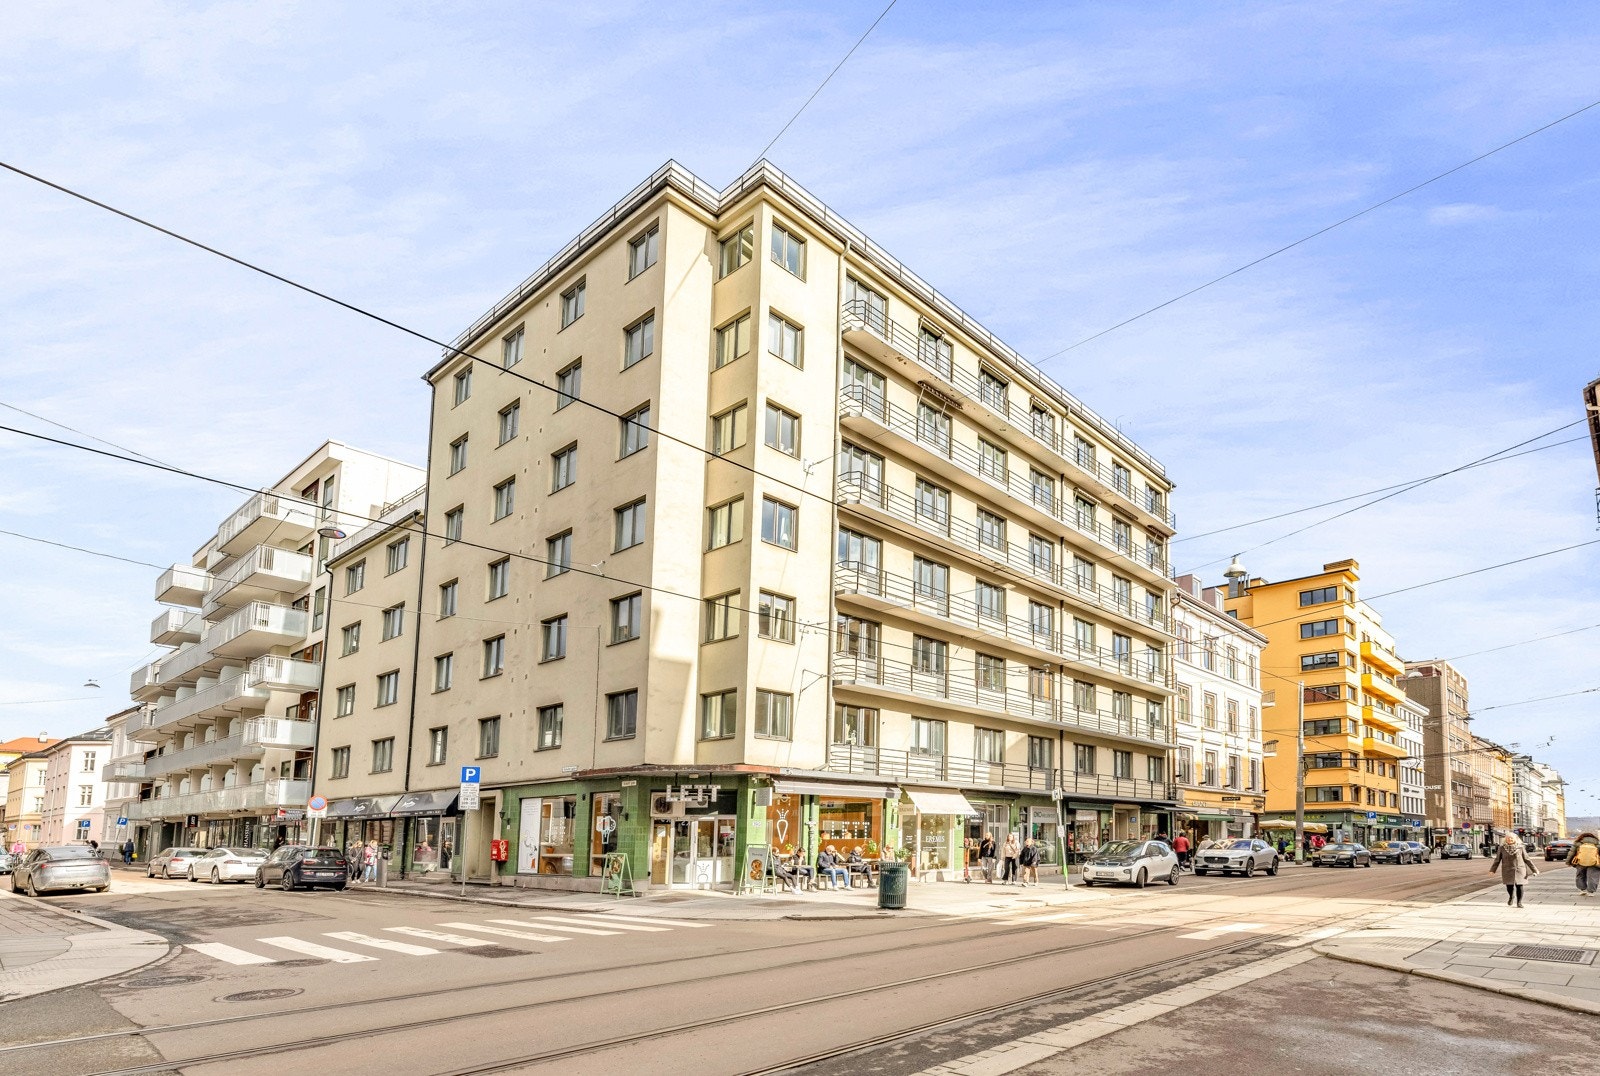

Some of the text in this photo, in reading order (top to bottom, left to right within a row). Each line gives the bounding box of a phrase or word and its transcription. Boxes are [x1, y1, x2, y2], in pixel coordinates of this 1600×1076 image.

[466, 768, 476, 781] P
[666, 784, 721, 802] LETT
[831, 821, 870, 839] LETT
